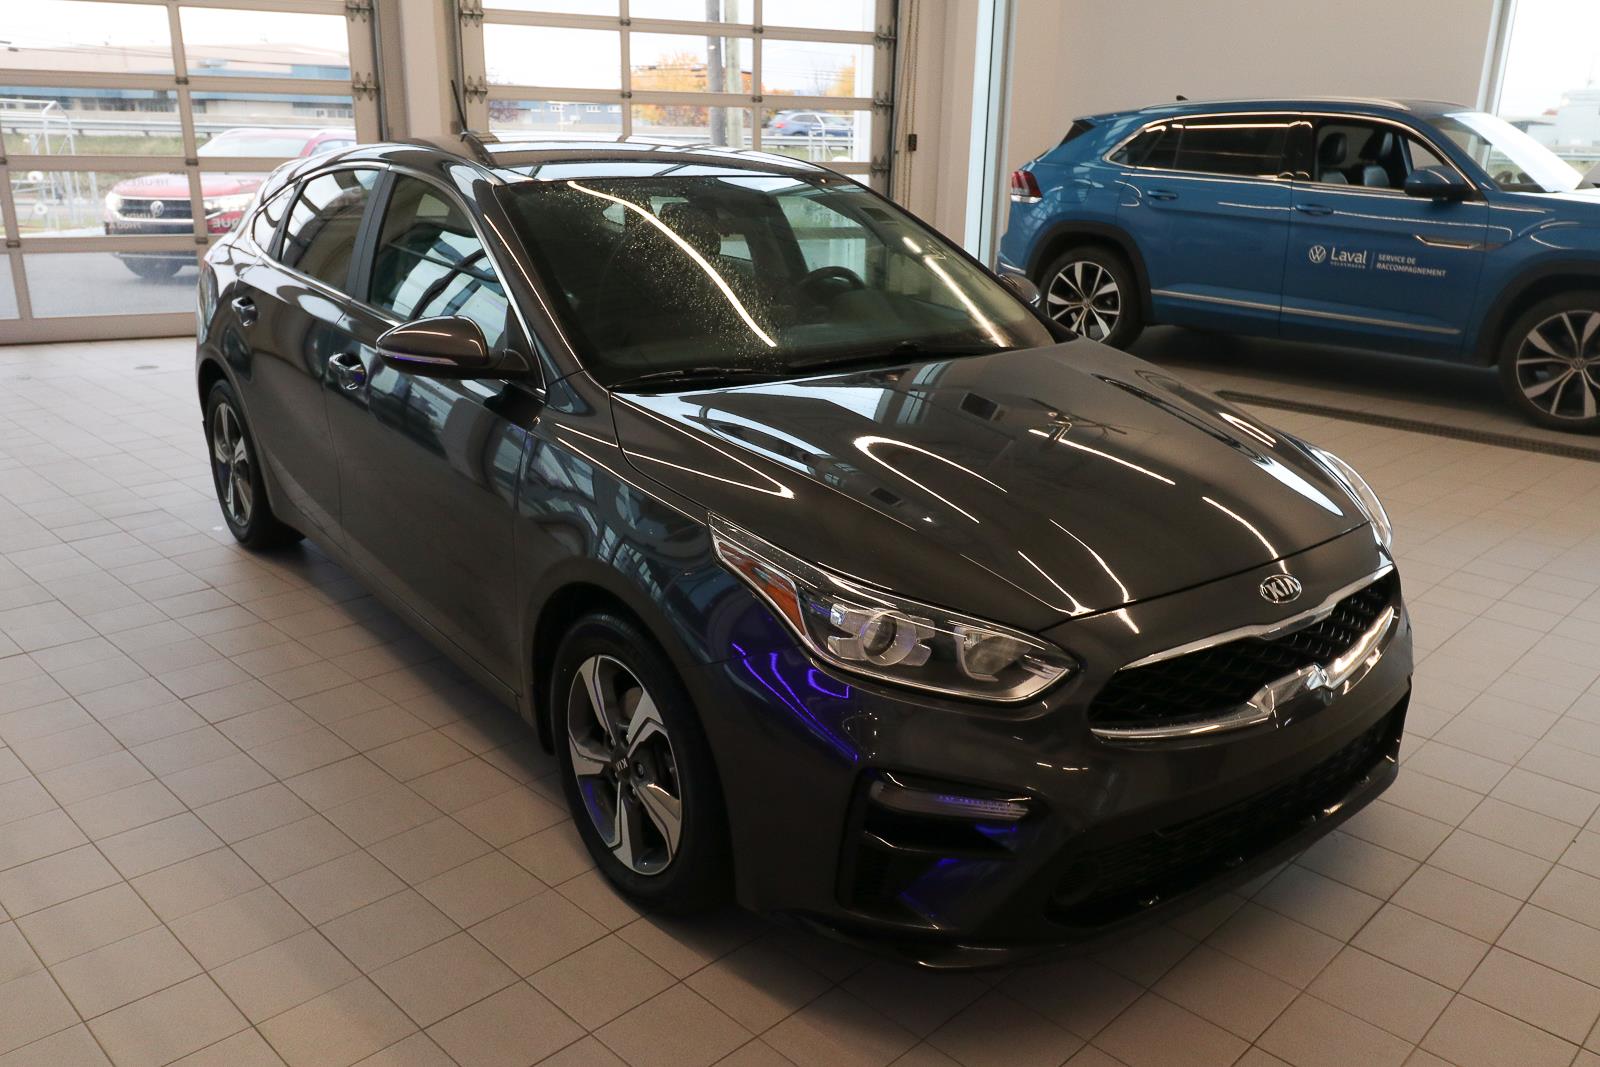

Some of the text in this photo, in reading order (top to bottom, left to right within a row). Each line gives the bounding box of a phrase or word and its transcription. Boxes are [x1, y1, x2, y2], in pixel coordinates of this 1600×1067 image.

[1331, 247, 1367, 264] Laval
[1378, 253, 1417, 265] SERVICE DE
[1376, 262, 1447, 277] RACCOMPAGNEMENT
[1264, 577, 1299, 600] KIA
